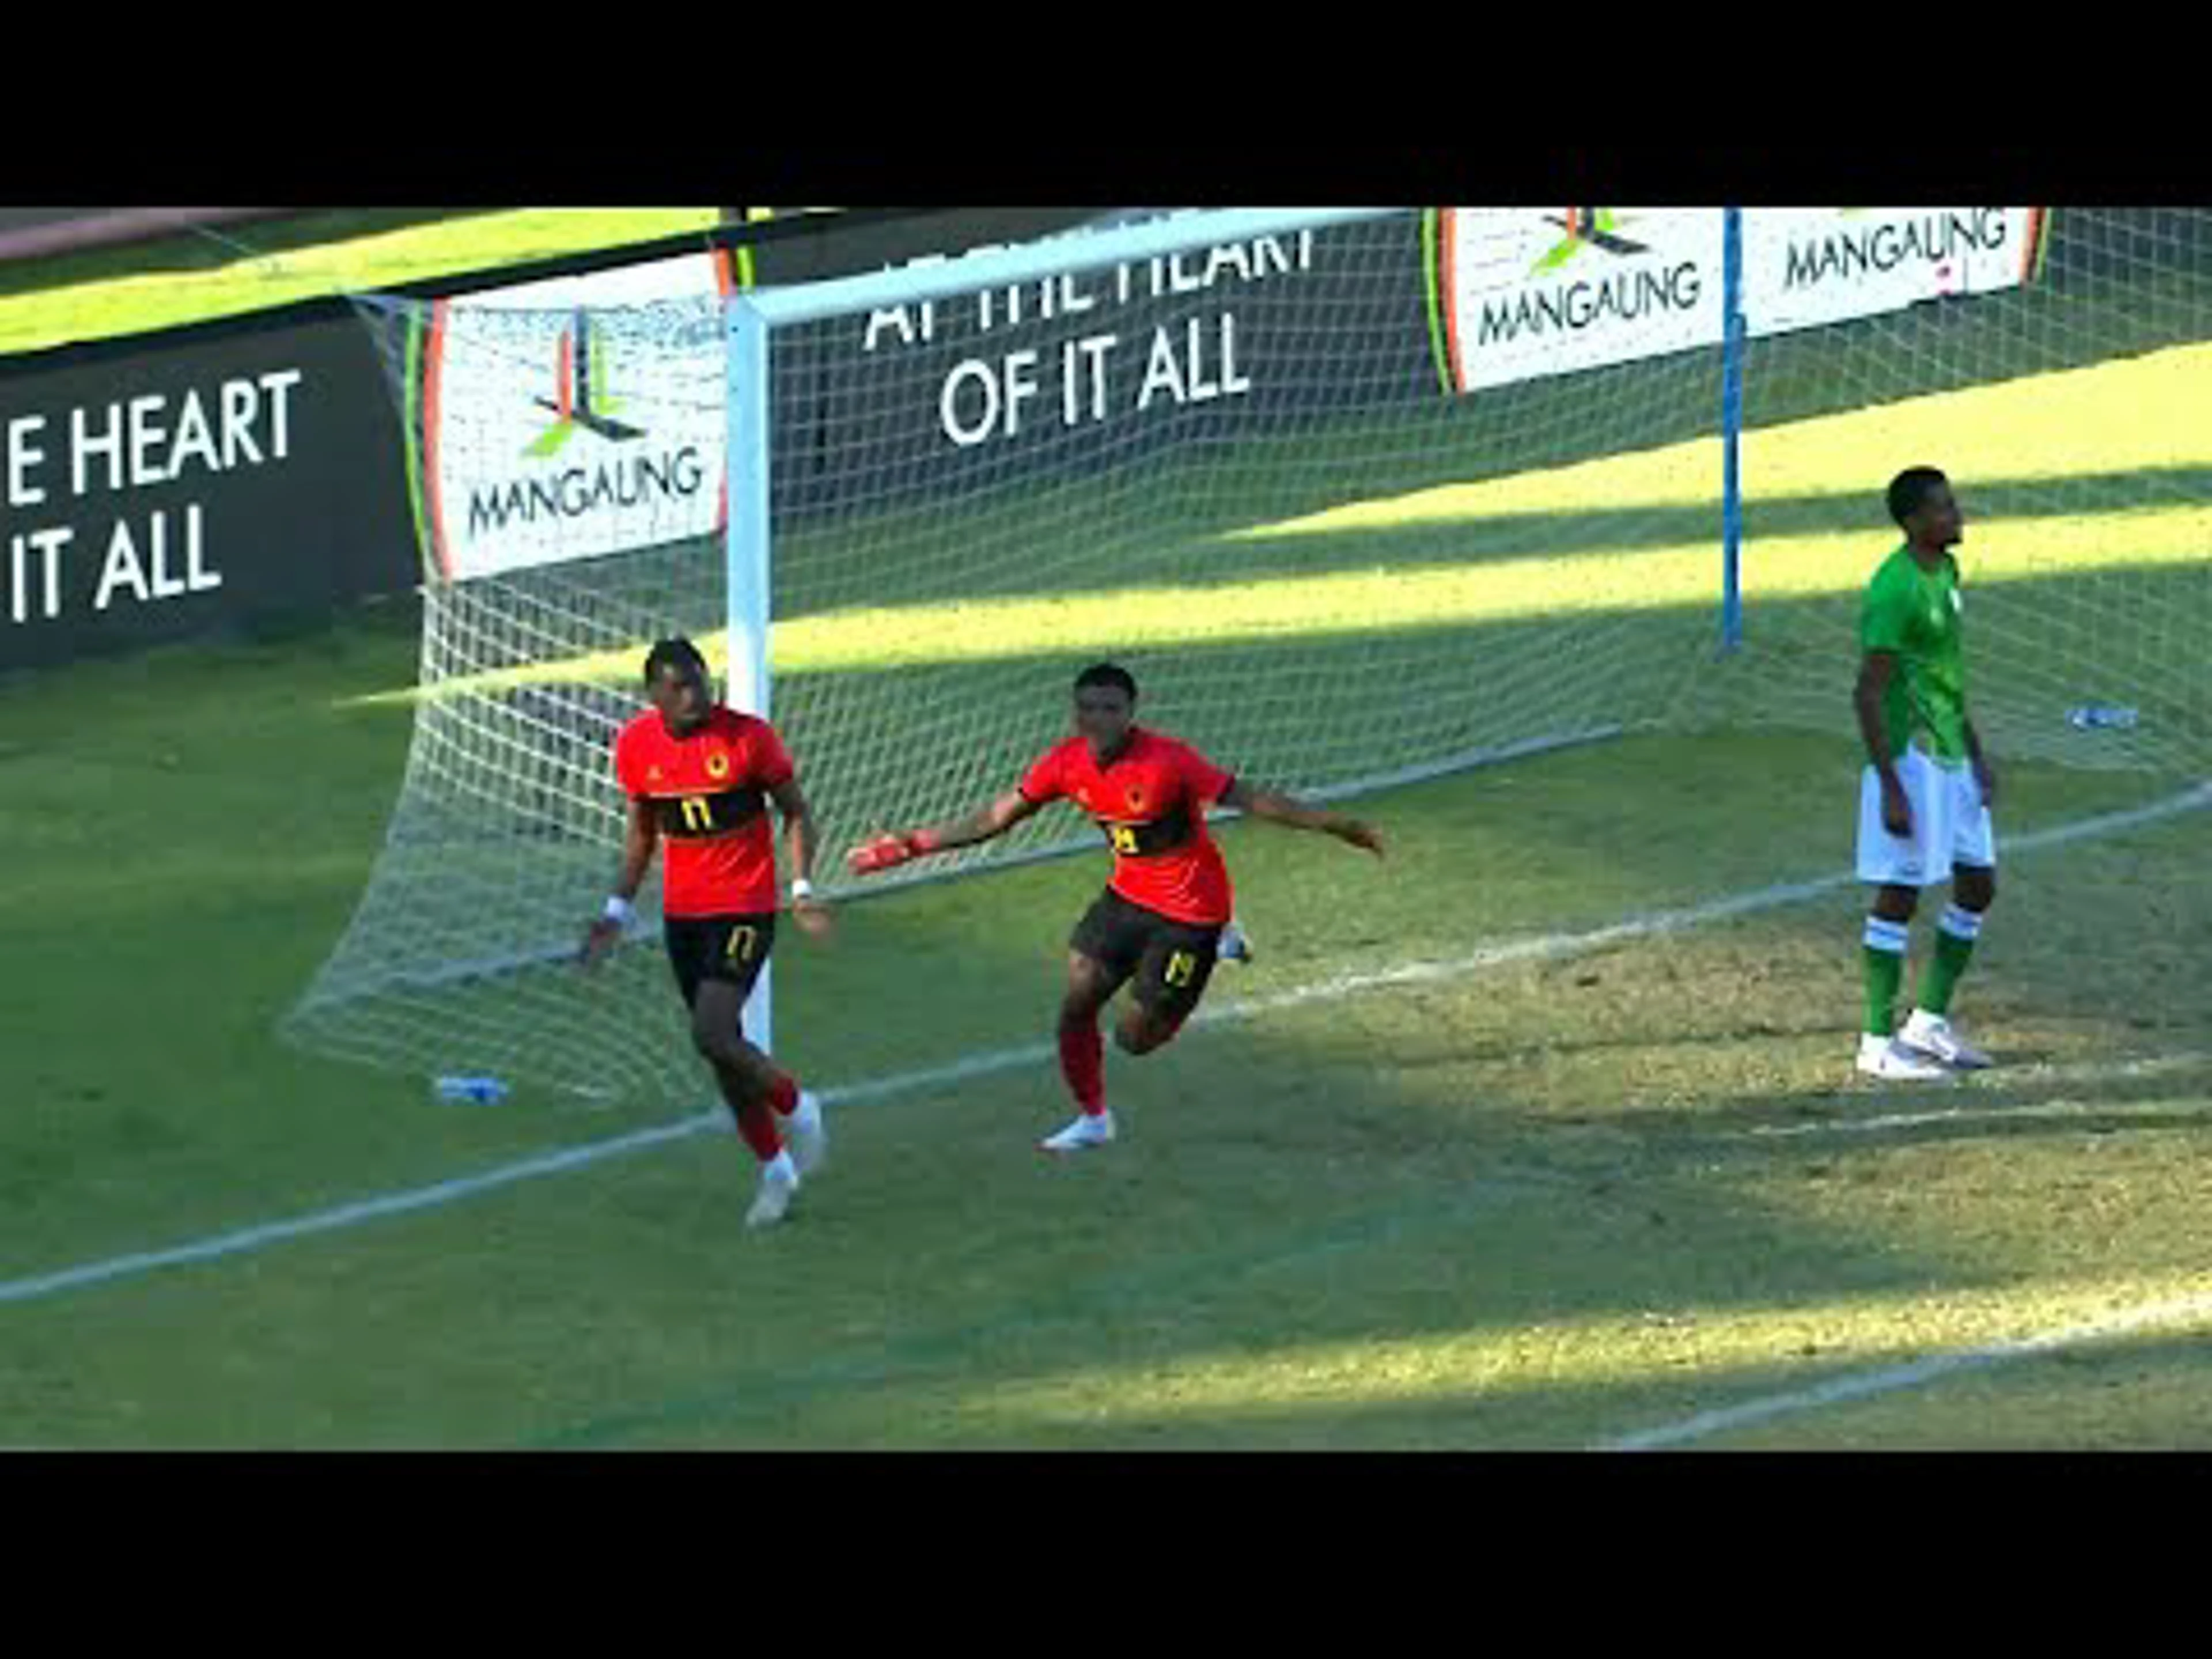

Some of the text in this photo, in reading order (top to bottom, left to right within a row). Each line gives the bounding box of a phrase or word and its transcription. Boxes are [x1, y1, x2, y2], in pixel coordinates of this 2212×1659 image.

[1785, 207, 2006, 287] MANGAUNG
[1478, 262, 1701, 347] MANGAUNG
[71, 369, 301, 495] HEART
[940, 312, 1251, 446] OF IT ALL
[469, 446, 702, 540] MANGAUNG
[12, 504, 222, 623] IT ALL
